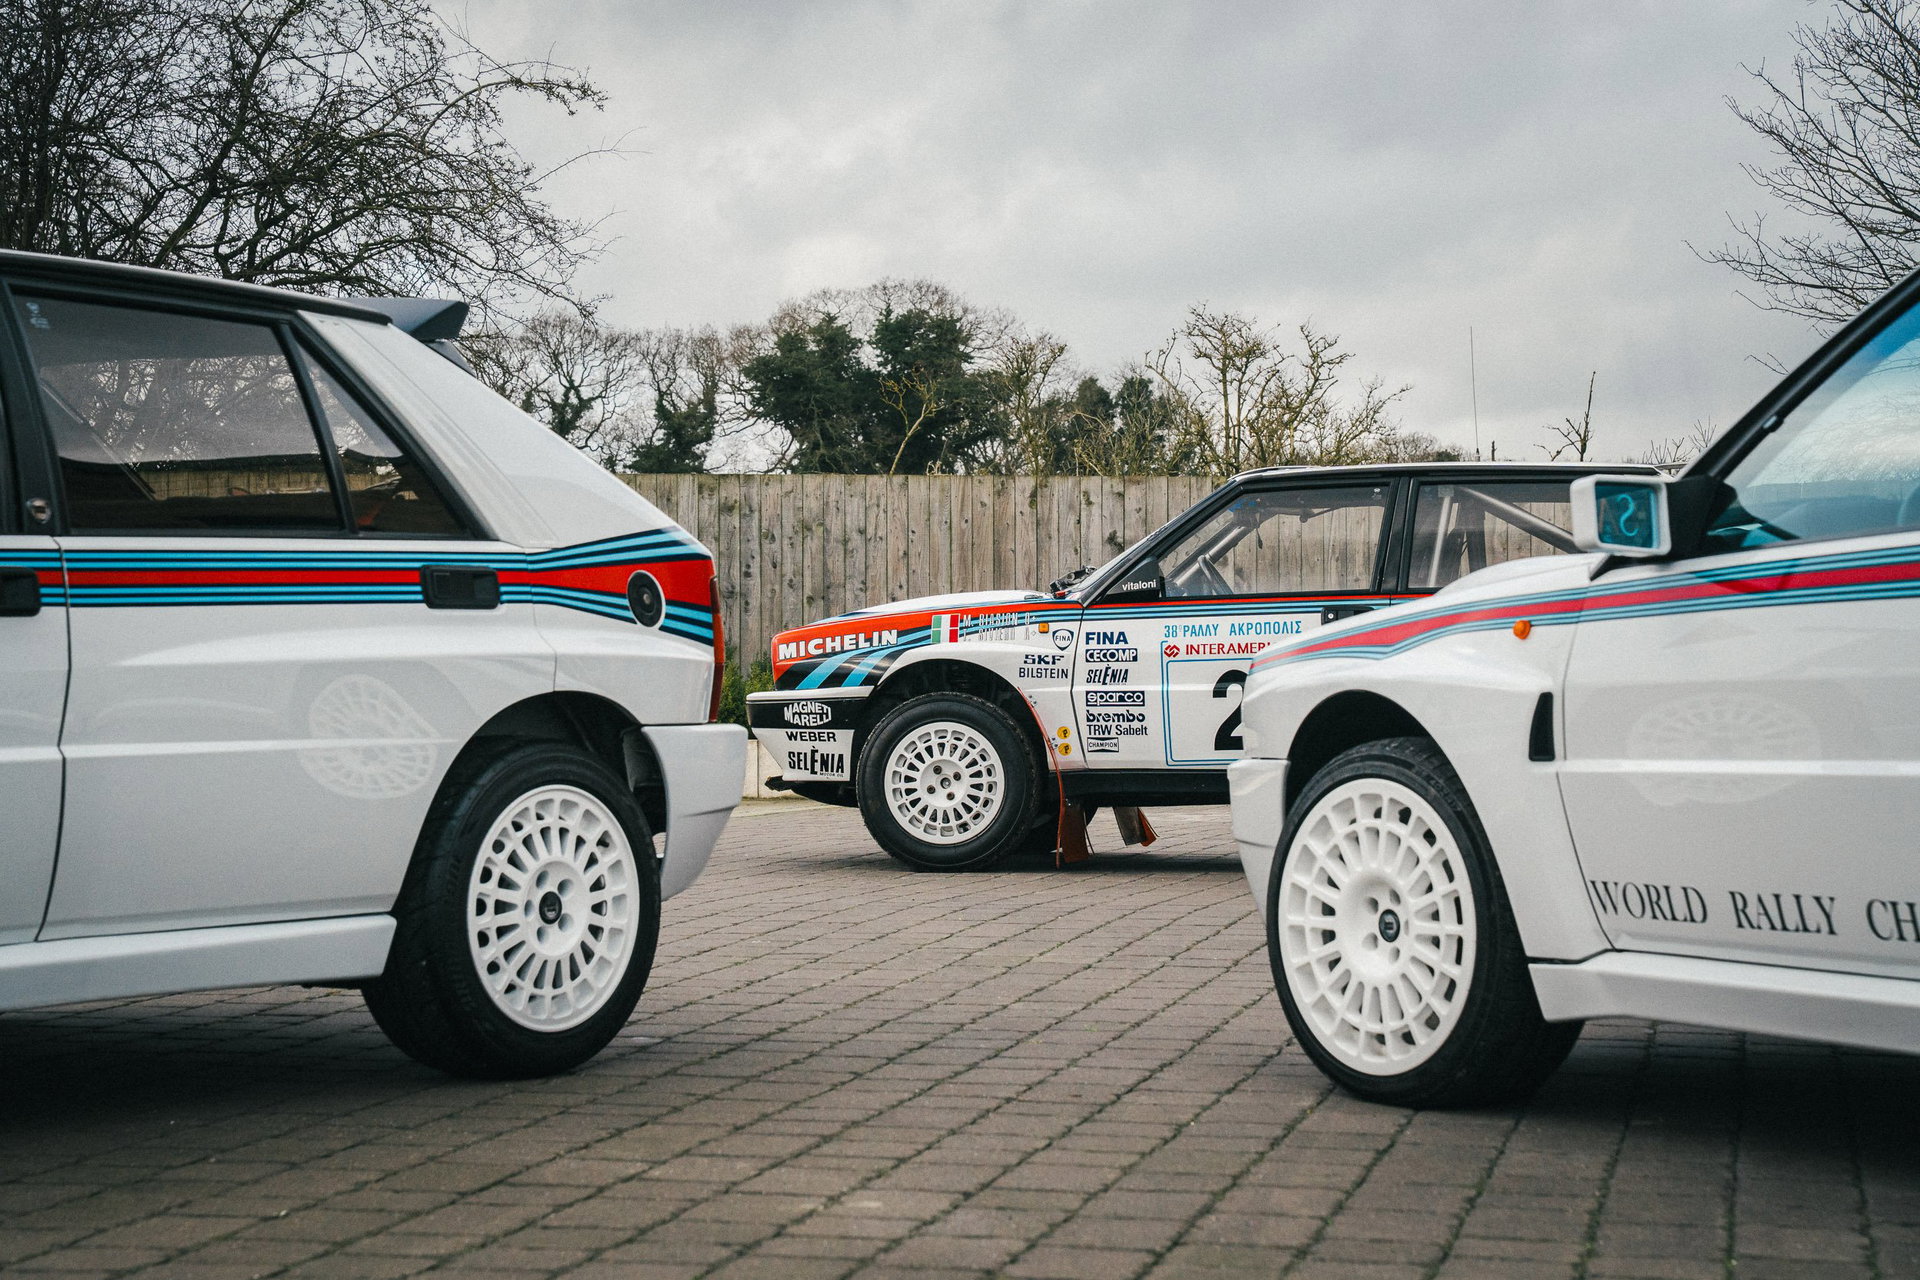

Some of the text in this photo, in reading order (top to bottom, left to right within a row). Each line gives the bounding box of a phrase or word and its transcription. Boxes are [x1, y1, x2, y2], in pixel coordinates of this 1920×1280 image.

[1122, 579, 1157, 591] vitaloni
[778, 629, 898, 661] MICHELIN
[1085, 631, 1129, 645] FINA
[1086, 649, 1137, 662] CECOMP
[1185, 642, 1271, 656] INTERAMER
[1023, 654, 1065, 665] SKF
[1018, 667, 1069, 679] BILSTEIN
[1087, 692, 1144, 706] sparco
[784, 701, 832, 715] MAGNETI
[1086, 709, 1146, 723] brembo
[785, 730, 837, 742] WEBER
[1086, 724, 1149, 736] TRW Sabelt
[1590, 880, 1920, 943] WORLD RALLY CH
